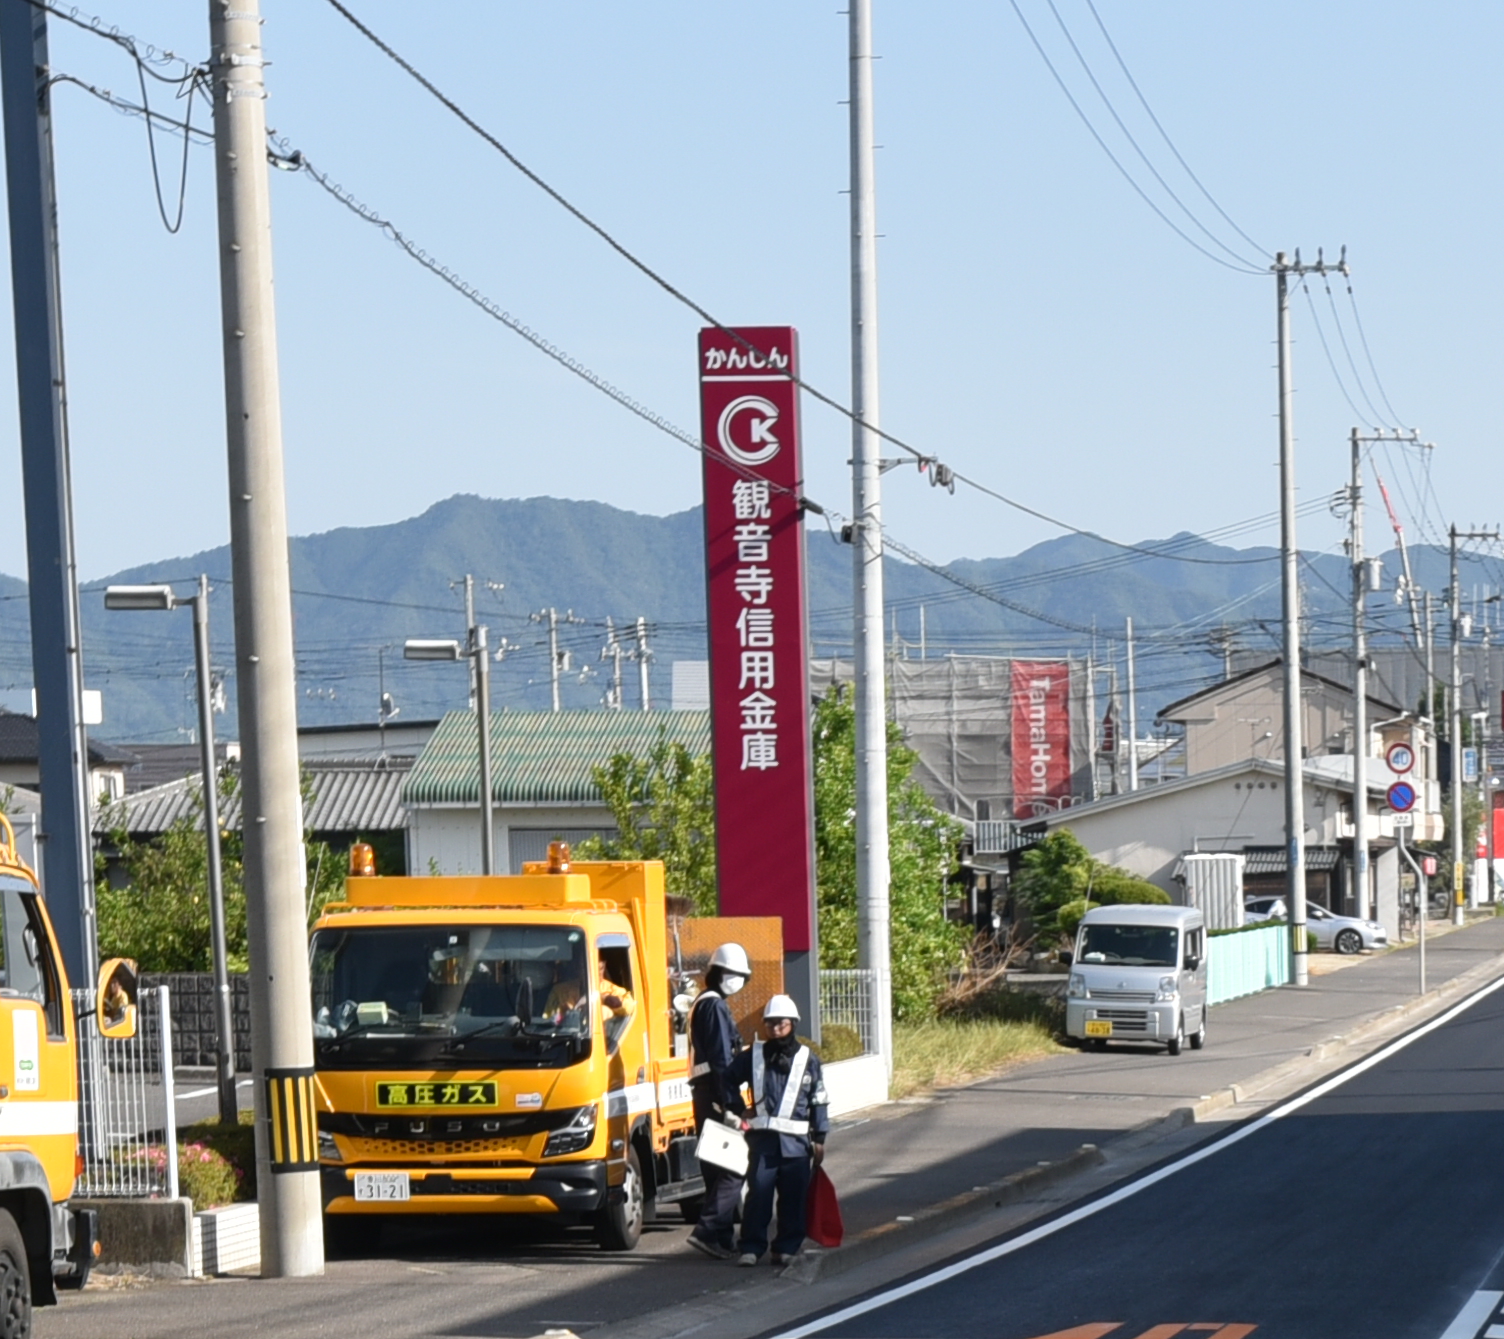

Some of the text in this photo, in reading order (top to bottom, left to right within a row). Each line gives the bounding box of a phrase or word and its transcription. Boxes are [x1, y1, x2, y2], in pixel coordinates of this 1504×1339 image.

[704, 346, 789, 370] かんしん
[732, 478, 779, 771] 観音寺信用金庫
[1392, 749, 1410, 766] 40
[387, 1085, 487, 1105] 高圧ガス
[375, 1121, 500, 1133] FUSO
